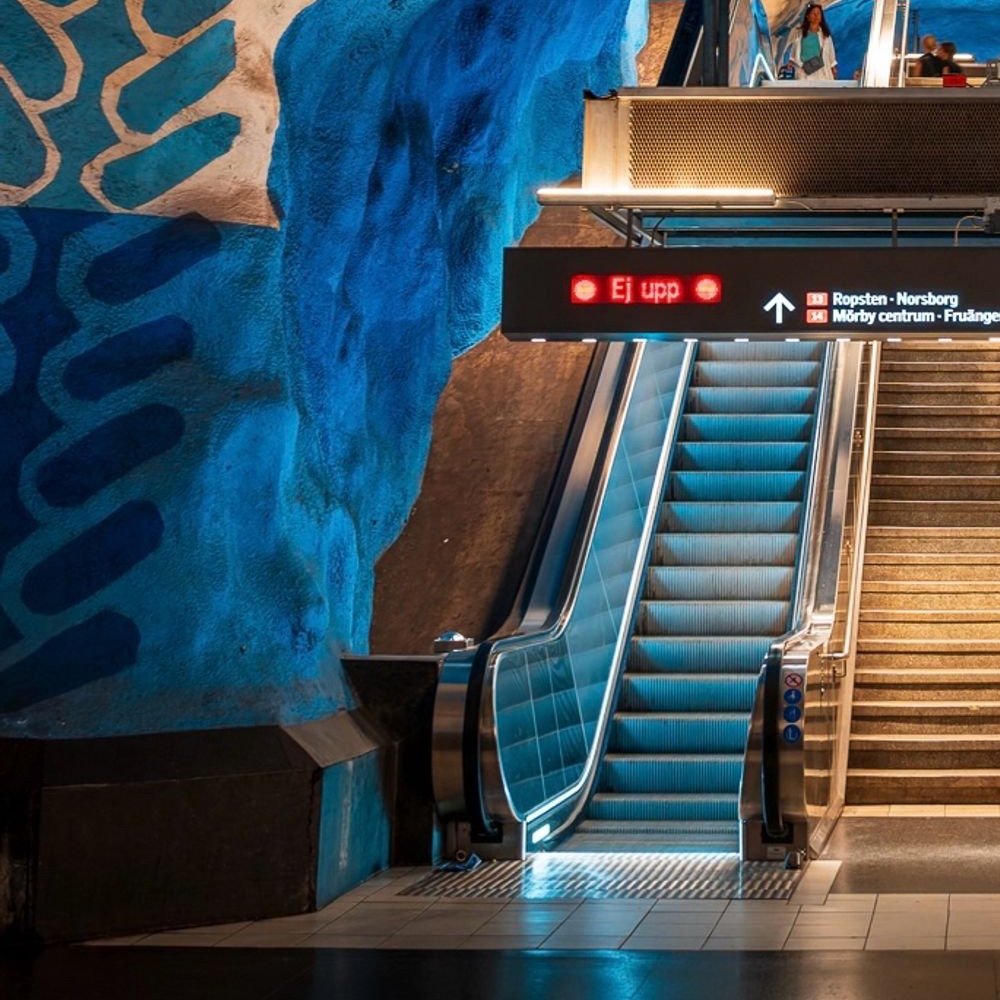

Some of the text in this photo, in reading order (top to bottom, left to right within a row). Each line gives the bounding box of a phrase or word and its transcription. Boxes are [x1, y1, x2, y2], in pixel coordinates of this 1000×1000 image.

[611, 276, 680, 304] Ej upp
[833, 291, 887, 309] Ropsten
[897, 291, 958, 309] Norsborg
[833, 308, 876, 326] Mörby
[878, 310, 935, 322] centrum
